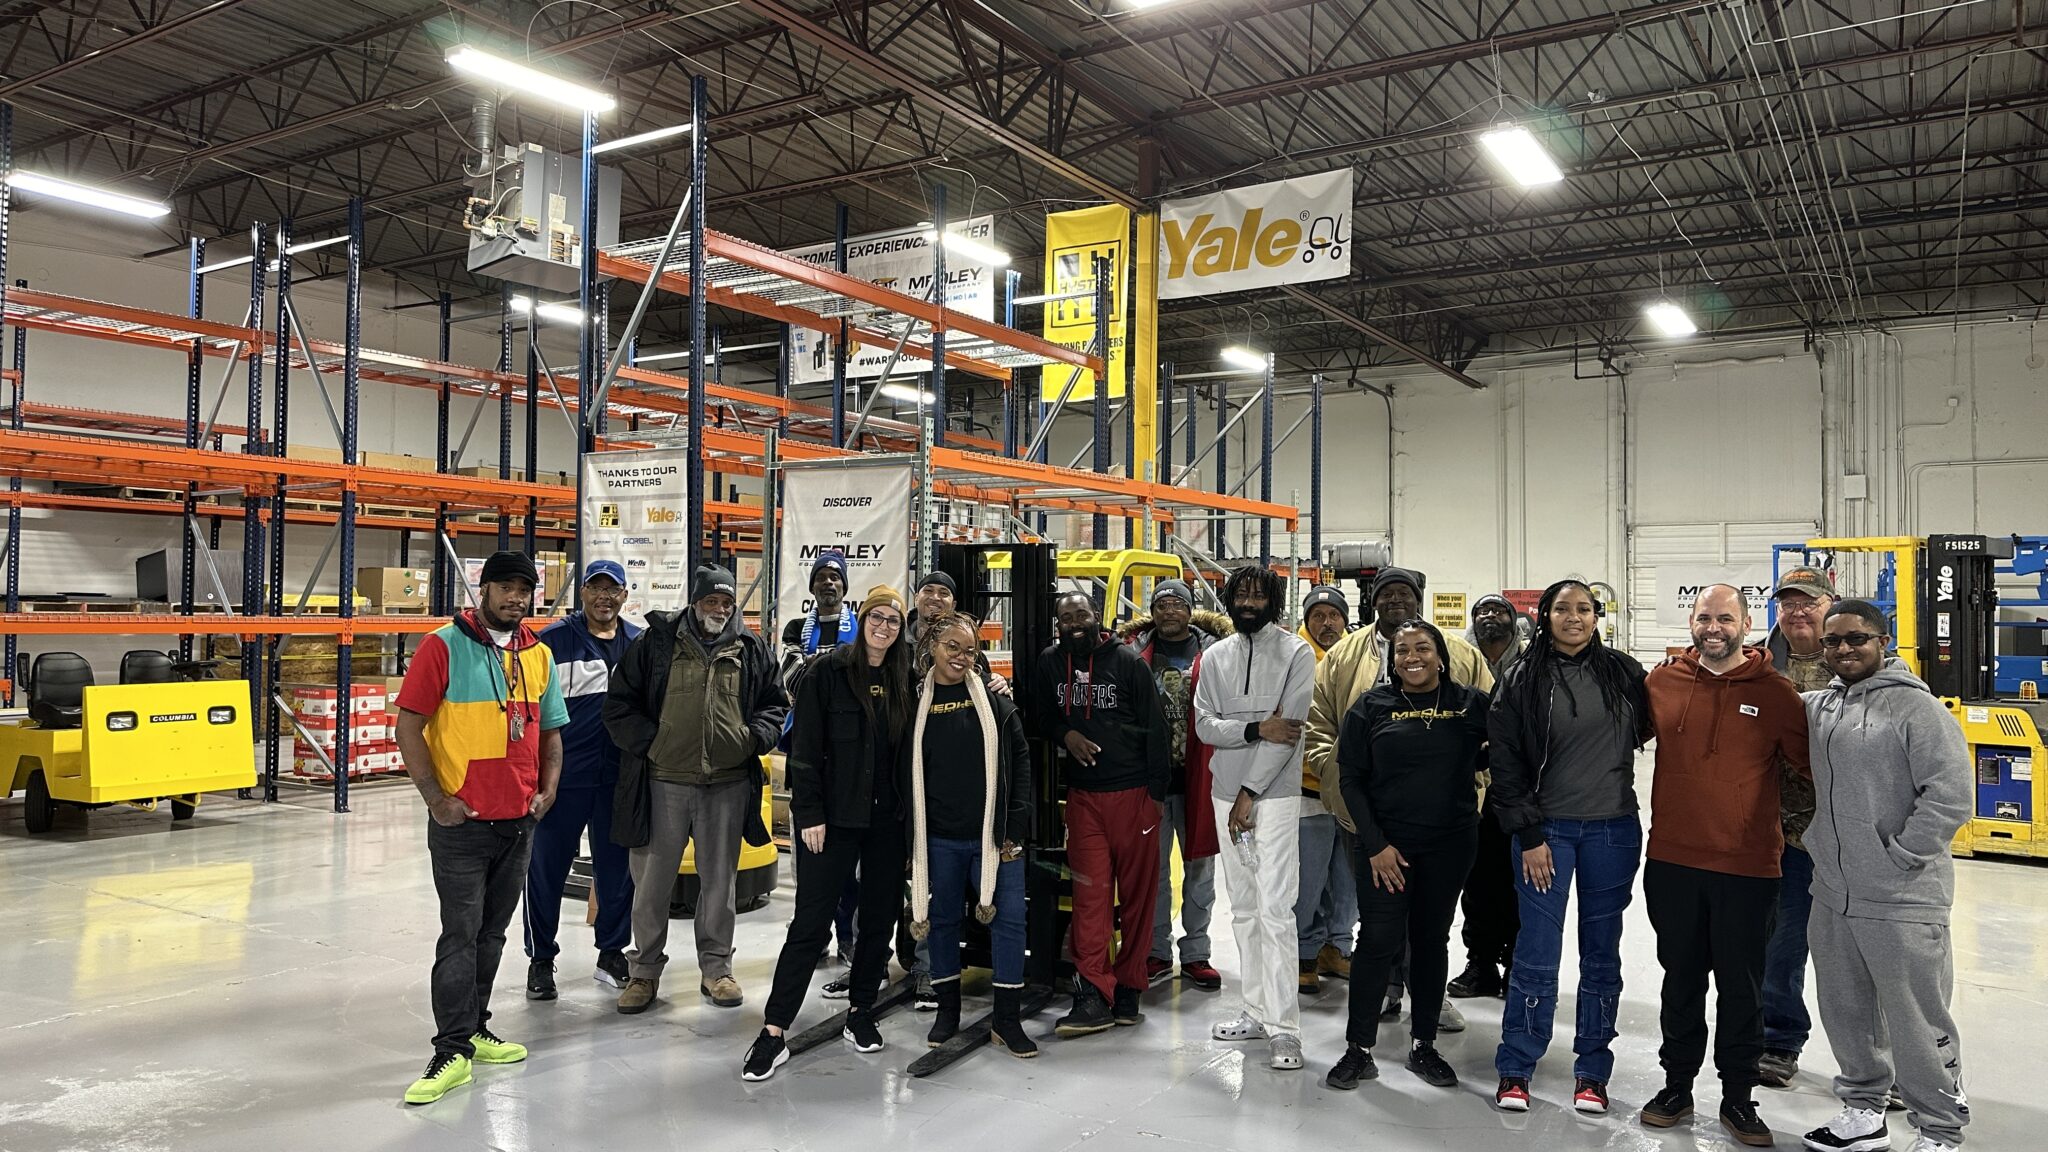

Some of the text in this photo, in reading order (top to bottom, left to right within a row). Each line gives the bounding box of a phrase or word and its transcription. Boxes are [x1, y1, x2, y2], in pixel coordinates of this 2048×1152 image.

[848, 236, 929, 259] EXPERIENCE
[1162, 207, 1303, 280] Yale
[1082, 336, 1124, 350] PERS
[598, 466, 677, 478] THANKS TO OUR
[608, 477, 662, 488] PARTNERS
[823, 496, 872, 507] DISCOVER
[647, 507, 675, 523] Yale
[623, 537, 650, 545] GORBEL
[627, 559, 646, 567] Wells
[1937, 565, 1954, 602] Yale
[1678, 586, 1771, 595] MEY
[929, 699, 974, 713] EDLE
[152, 714, 195, 722] COLUMBIA
[1165, 712, 1188, 720] BAM
[1391, 708, 1467, 719] MEDLEY
